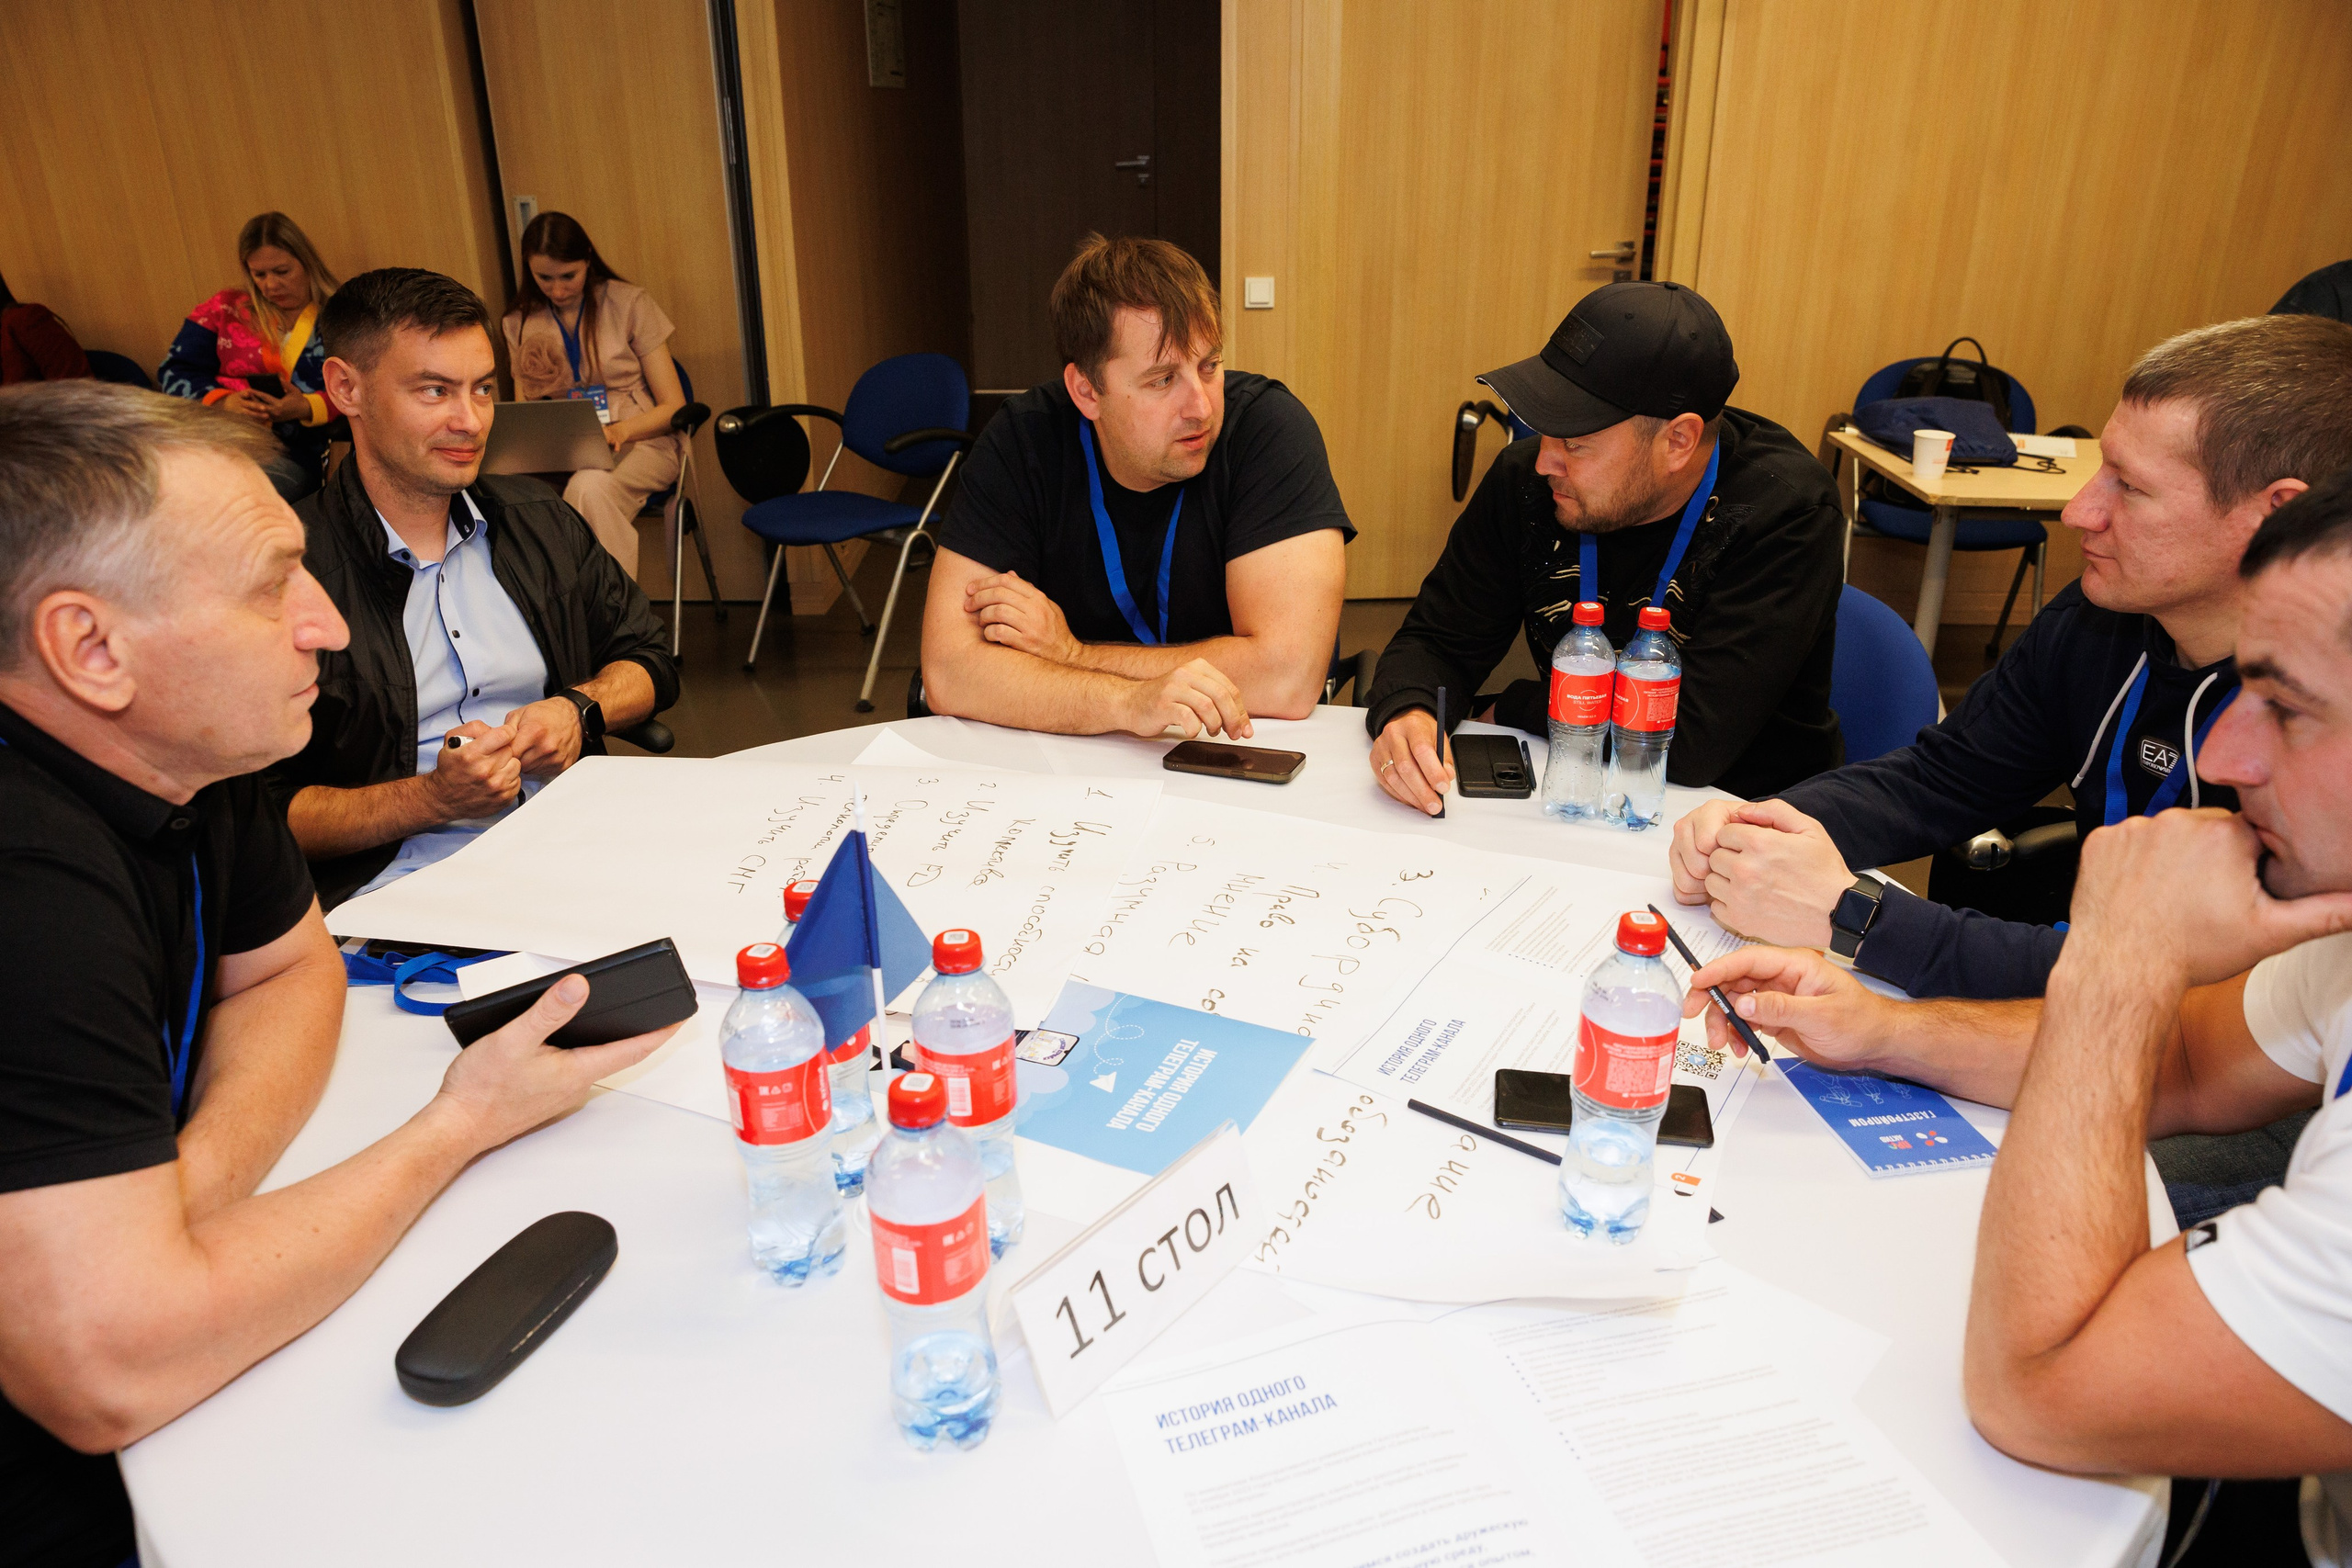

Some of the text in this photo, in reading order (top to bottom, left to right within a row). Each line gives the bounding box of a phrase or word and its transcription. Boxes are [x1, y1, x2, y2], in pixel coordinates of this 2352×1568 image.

[2142, 743, 2178, 770] EA7
[1376, 1019, 1438, 1077] ИСТОРИЯ ОДНОГО
[1399, 1019, 1467, 1085] ТЕЛЕГРАМ-КАНАЛА
[1105, 1038, 1201, 1131] ТЕЛЕГРАМ-КАНАЛА
[1135, 1047, 1218, 1133] ИСТОРИЯ ОДНОГО
[1848, 1110, 1938, 1128] ГАЗСТРОЙПРОМ
[1056, 1182, 1239, 1359] 11 СТОЛ
[1155, 1375, 1306, 1429] ИСТОРИЯ ОДНОГО
[1164, 1393, 1338, 1454] ТЕЛЕГРАМ-КАНАЛА
